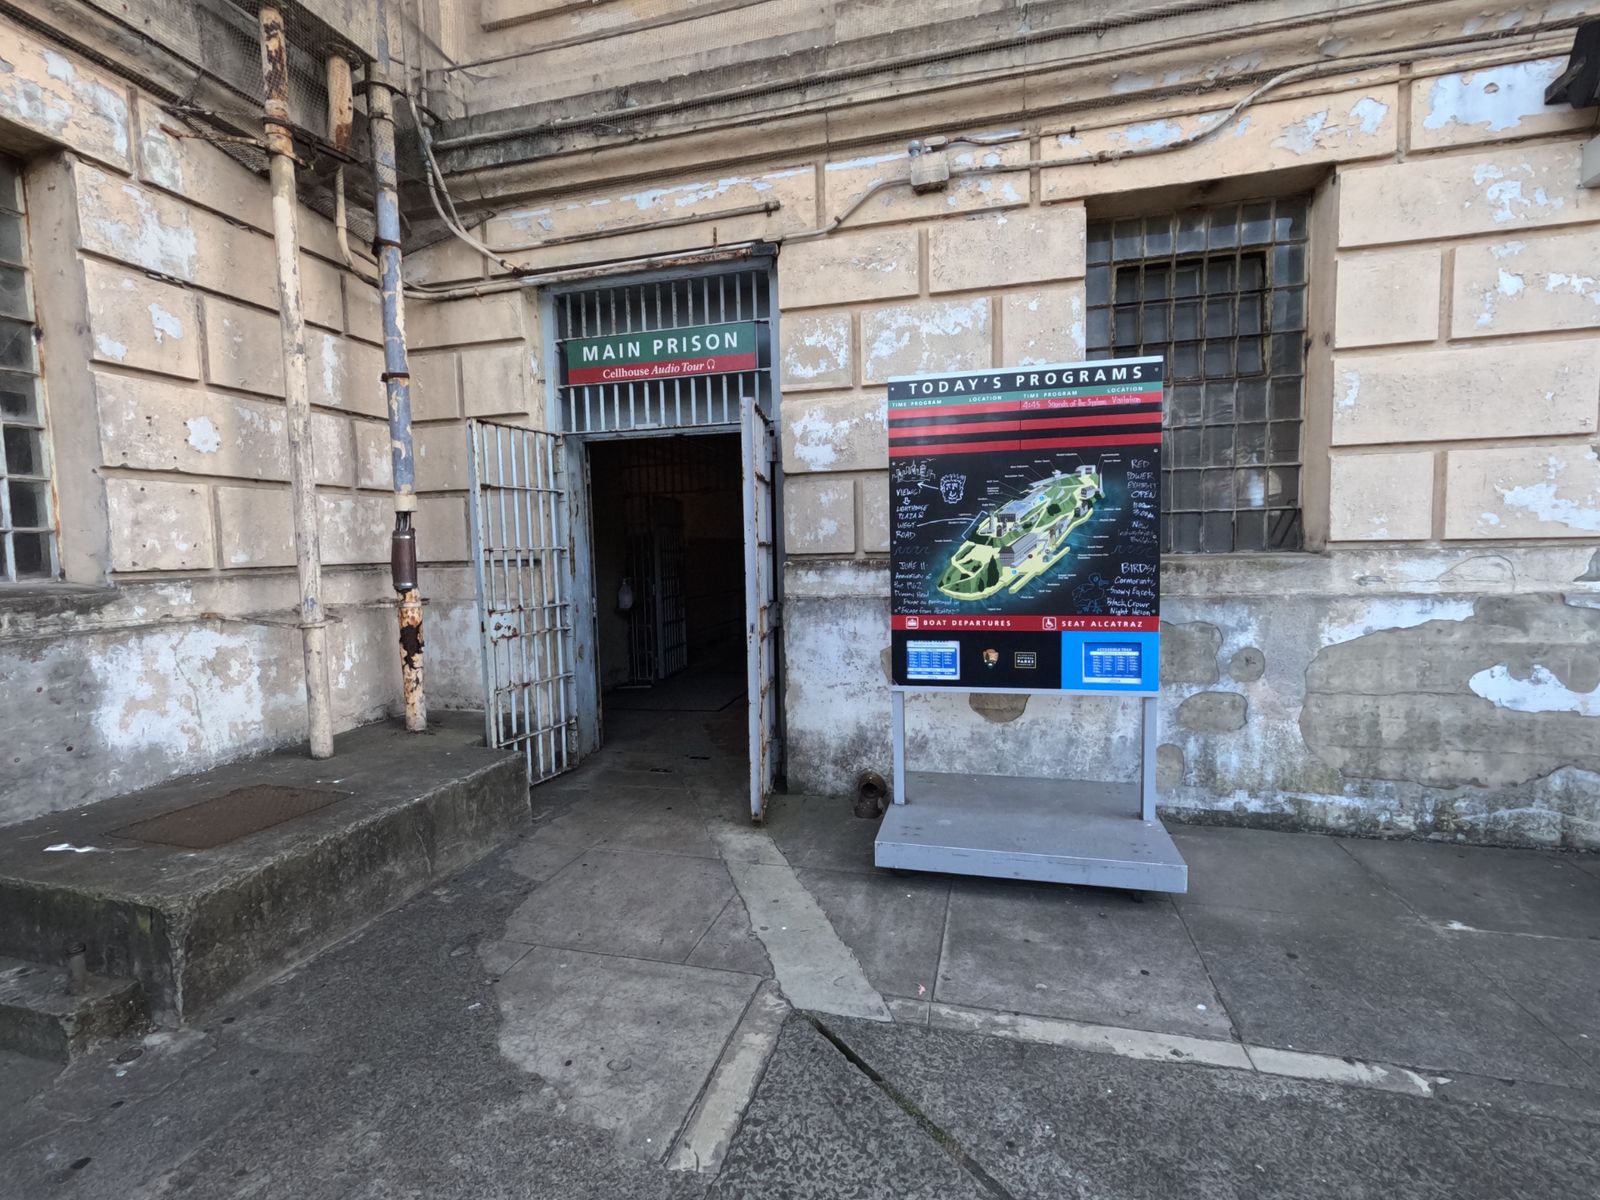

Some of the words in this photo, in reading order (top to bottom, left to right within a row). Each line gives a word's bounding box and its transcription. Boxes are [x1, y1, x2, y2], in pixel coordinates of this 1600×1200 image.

[583, 341, 640, 362] MAIN
[653, 331, 738, 355] PRISON
[603, 368, 649, 379] Cellhouse
[651, 363, 680, 375] Audio
[682, 361, 705, 372] Tour
[908, 376, 1002, 395] TODAY'S
[1016, 366, 1142, 387] PROGRAMS
[1022, 400, 1041, 409] 4:45
[1069, 398, 1077, 407] of
[1131, 459, 1150, 469] RED
[1126, 471, 1154, 480] POWER
[1130, 490, 1157, 498] OPEN
[898, 561, 917, 570] JUNE
[1121, 562, 1156, 576] BIRDS!
[1109, 607, 1129, 616] Night
[1090, 620, 1143, 628] ALCATRAZ
